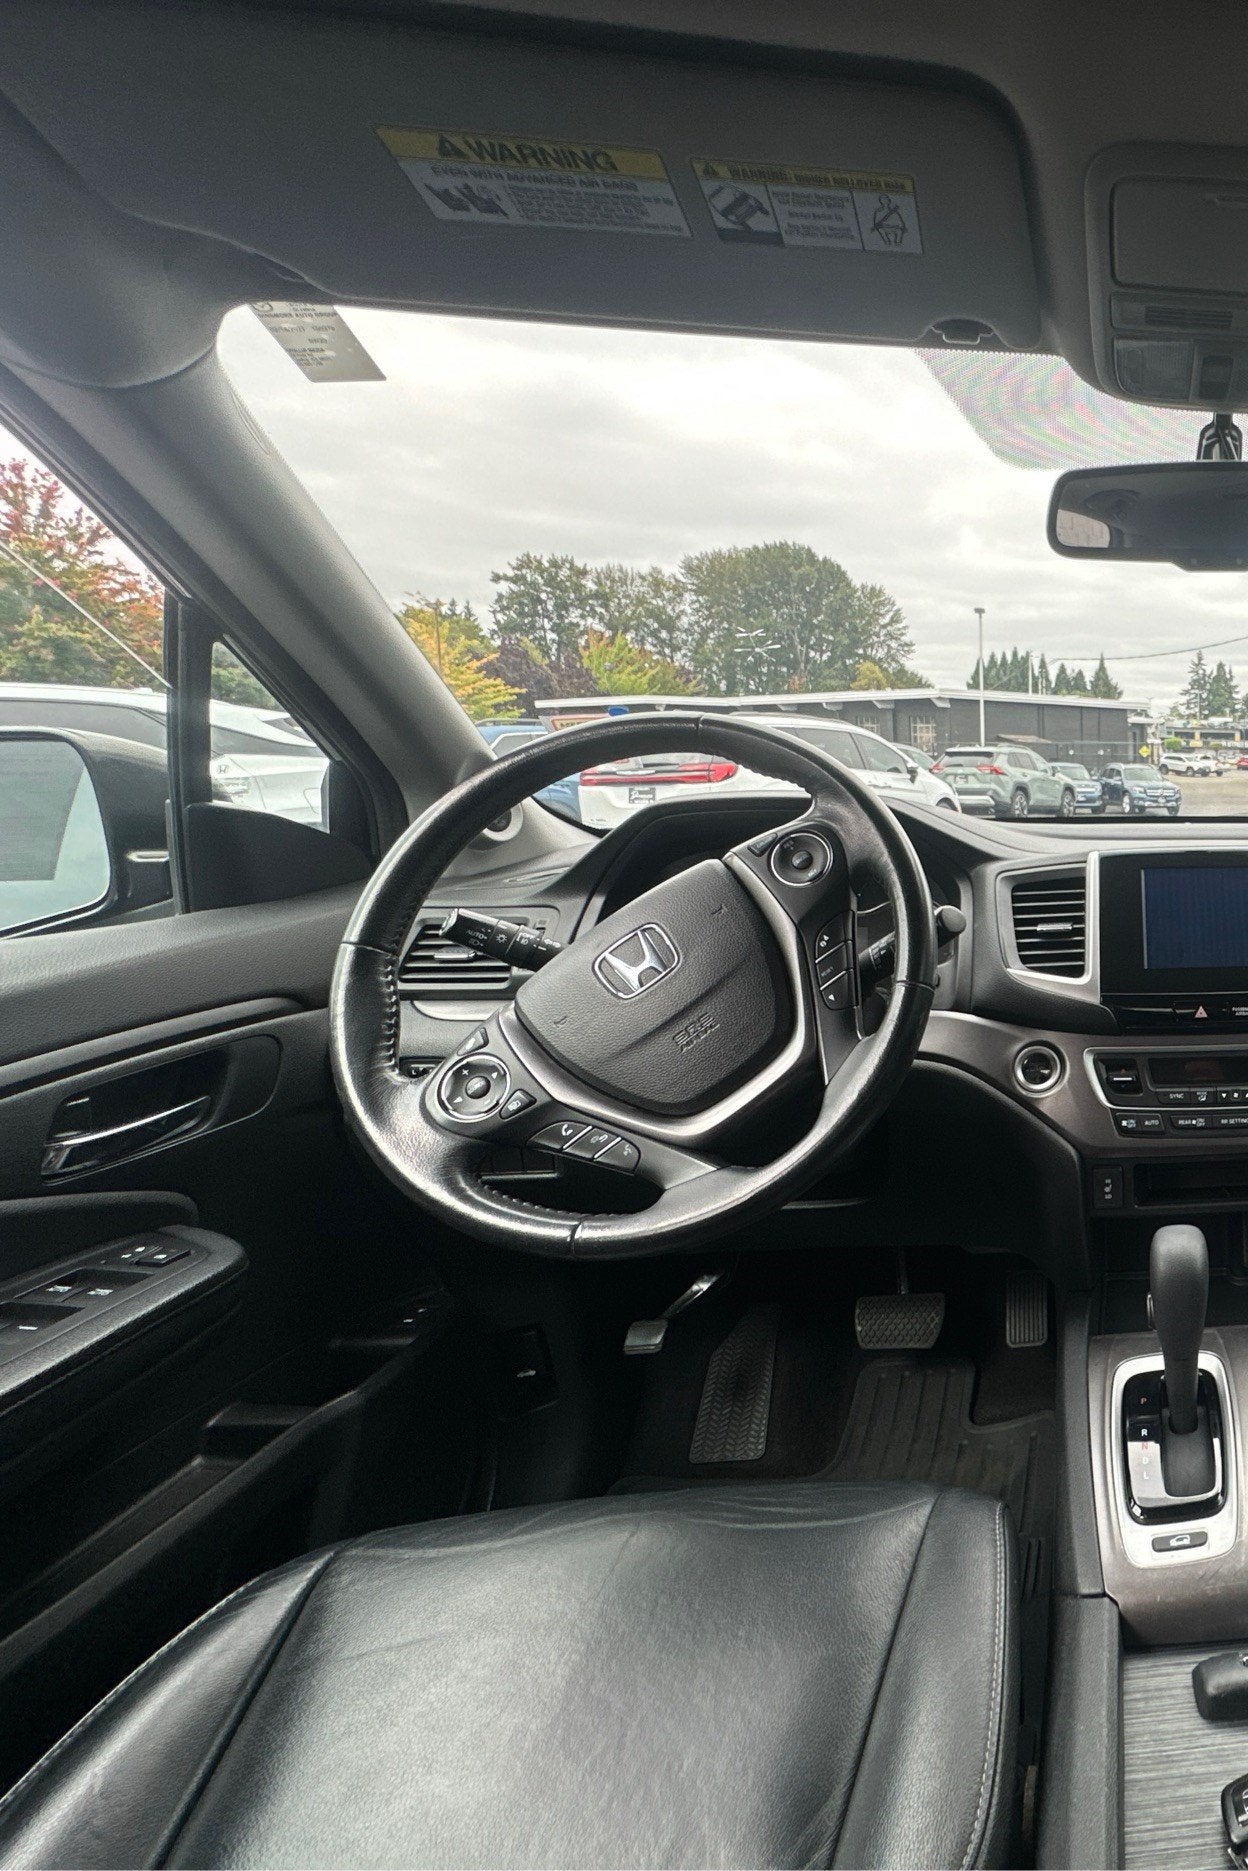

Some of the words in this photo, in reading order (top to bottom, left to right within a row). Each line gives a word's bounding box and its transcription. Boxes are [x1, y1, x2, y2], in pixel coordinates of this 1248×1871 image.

[461, 133, 619, 172] WARNING
[1140, 1397, 1147, 1405] P
[1141, 1428, 1148, 1436] R
[1141, 1442, 1149, 1450] N
[1142, 1456, 1149, 1465] D
[1143, 1471, 1149, 1480] L
